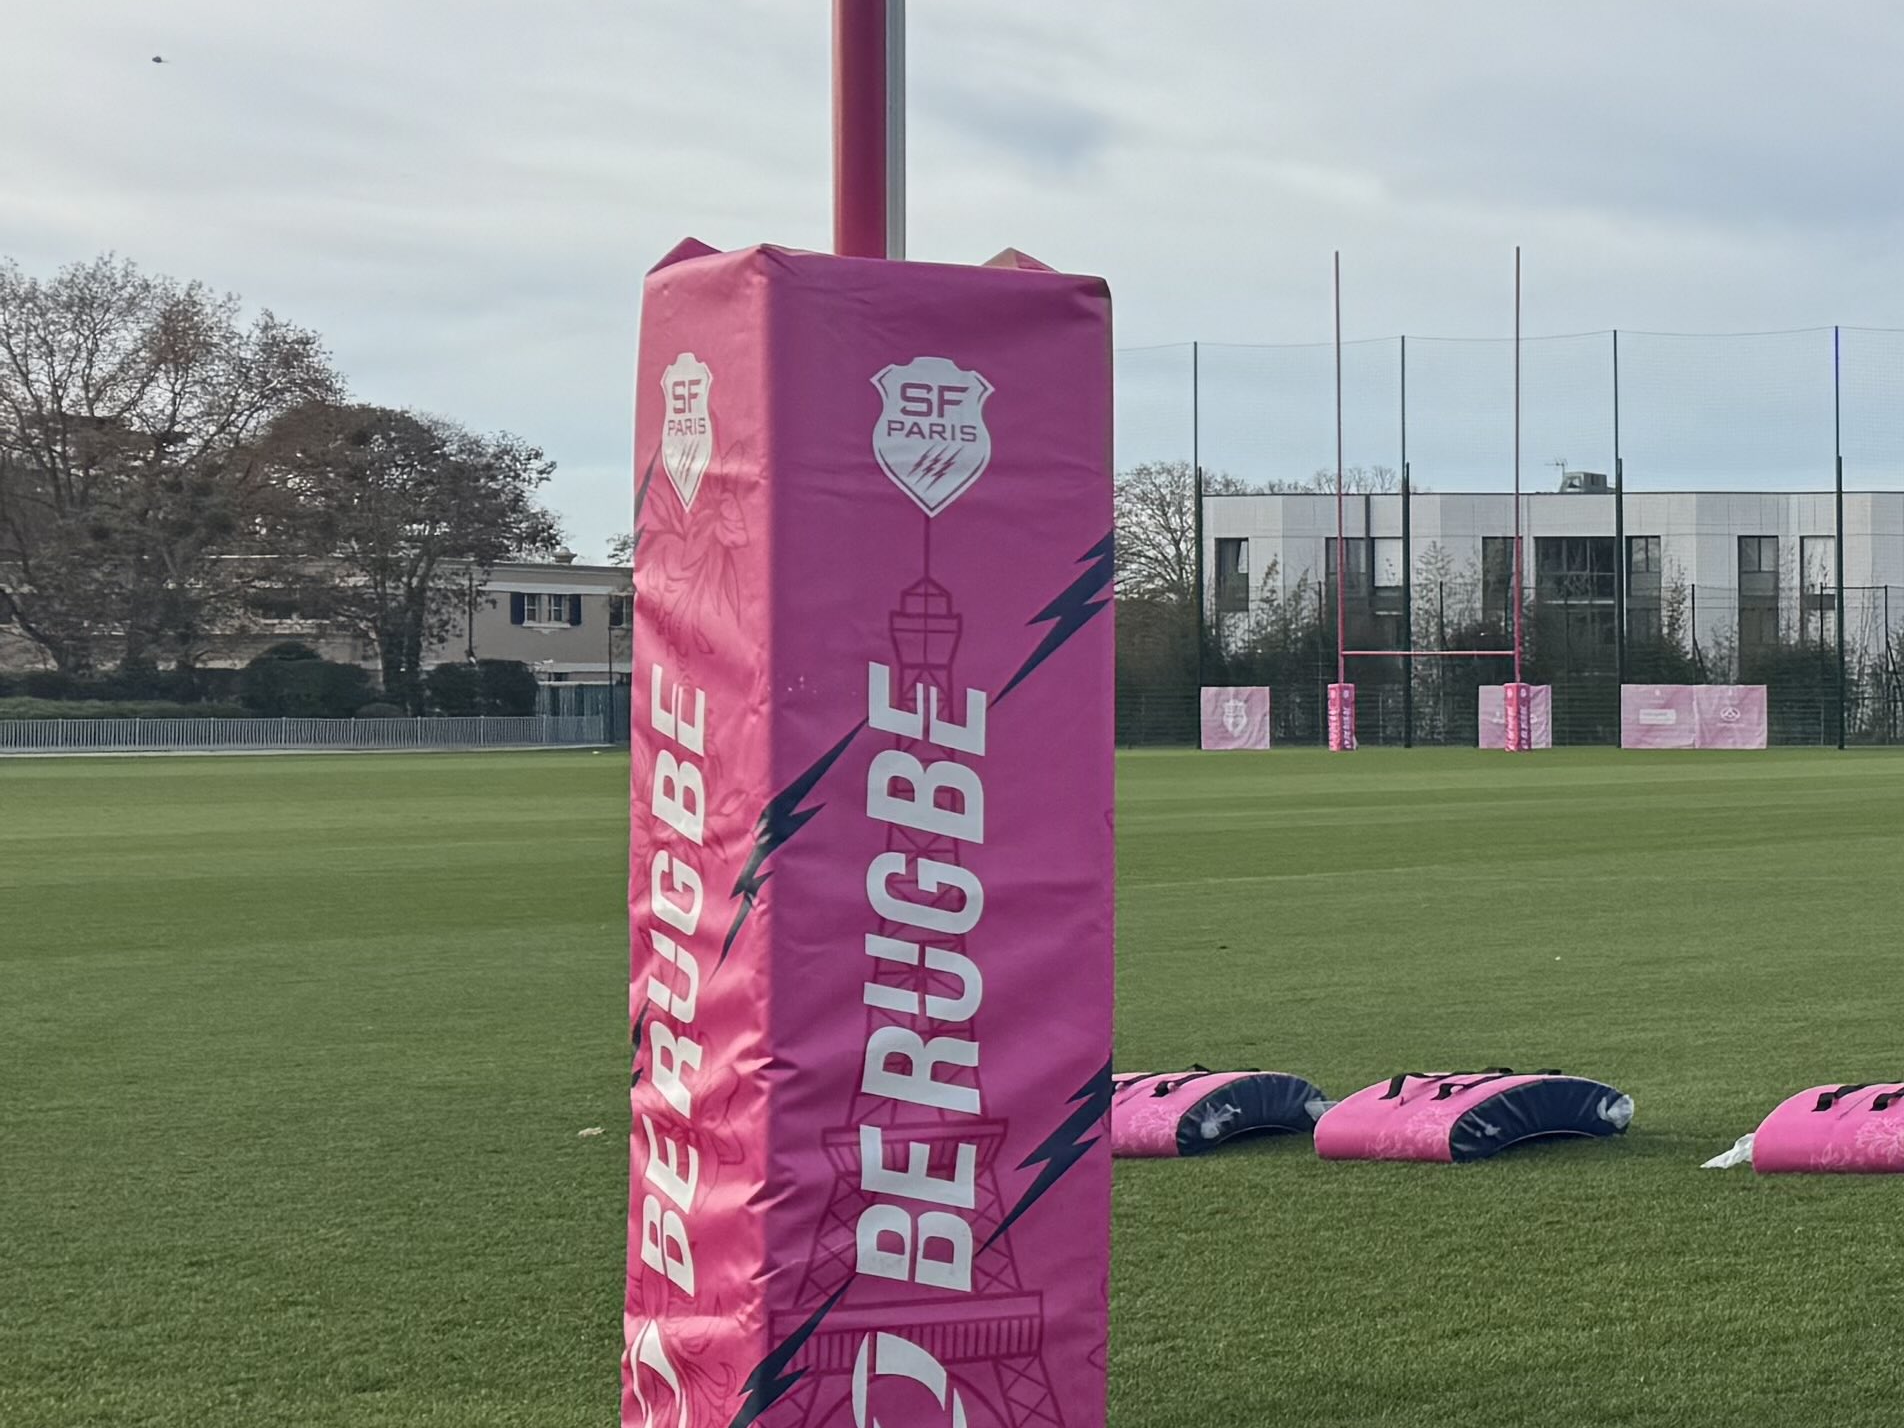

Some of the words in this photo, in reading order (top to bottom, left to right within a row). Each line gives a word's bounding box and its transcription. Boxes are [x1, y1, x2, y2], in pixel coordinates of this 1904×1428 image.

[671, 378, 703, 415] SF
[899, 382, 970, 419] SF
[667, 417, 707, 437] PARIS
[886, 419, 978, 443] PARIS
[861, 661, 988, 1115] RUGBE
[638, 1112, 697, 1298] BE
[856, 1124, 978, 1293] BE
